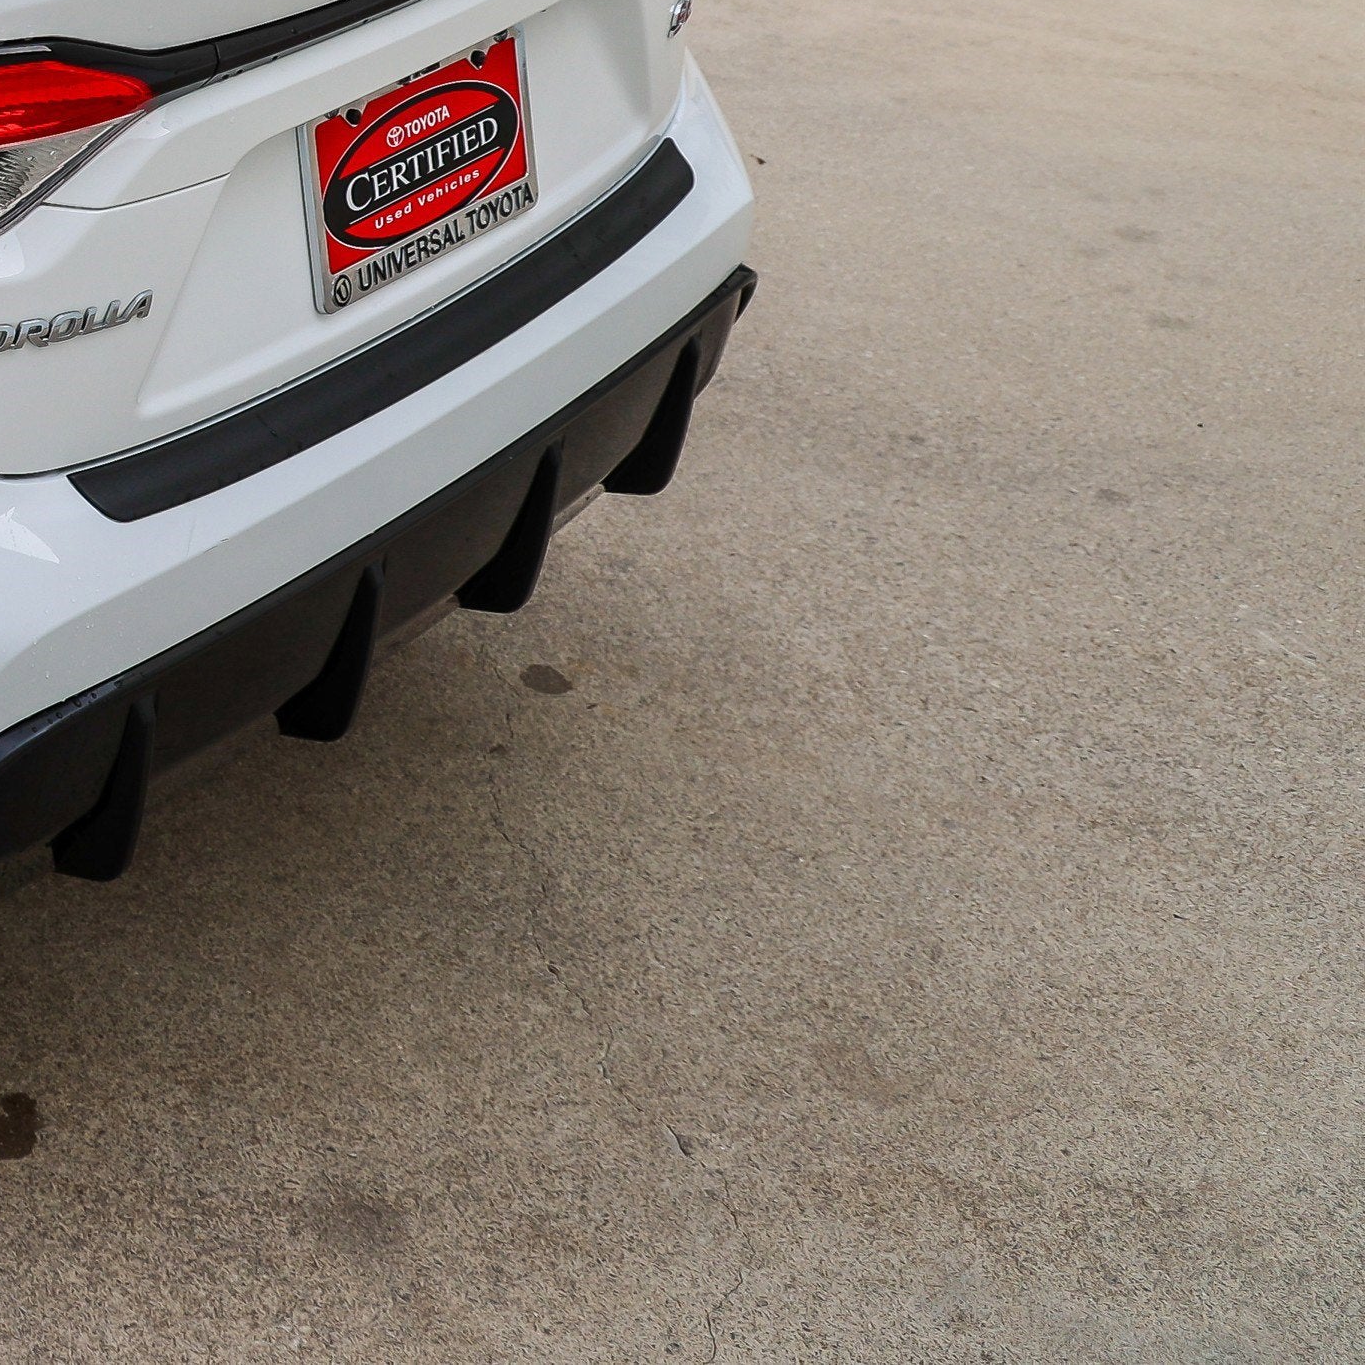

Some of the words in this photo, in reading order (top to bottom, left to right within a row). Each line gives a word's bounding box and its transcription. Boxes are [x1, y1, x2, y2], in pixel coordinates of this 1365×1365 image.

[405, 105, 450, 138] TOYOTA
[346, 117, 498, 212] CERTIFIED
[375, 203, 412, 229] Used
[418, 169, 481, 206] Vehicles
[358, 220, 465, 291] UNIVERSAL
[465, 182, 535, 236] TOYOTA
